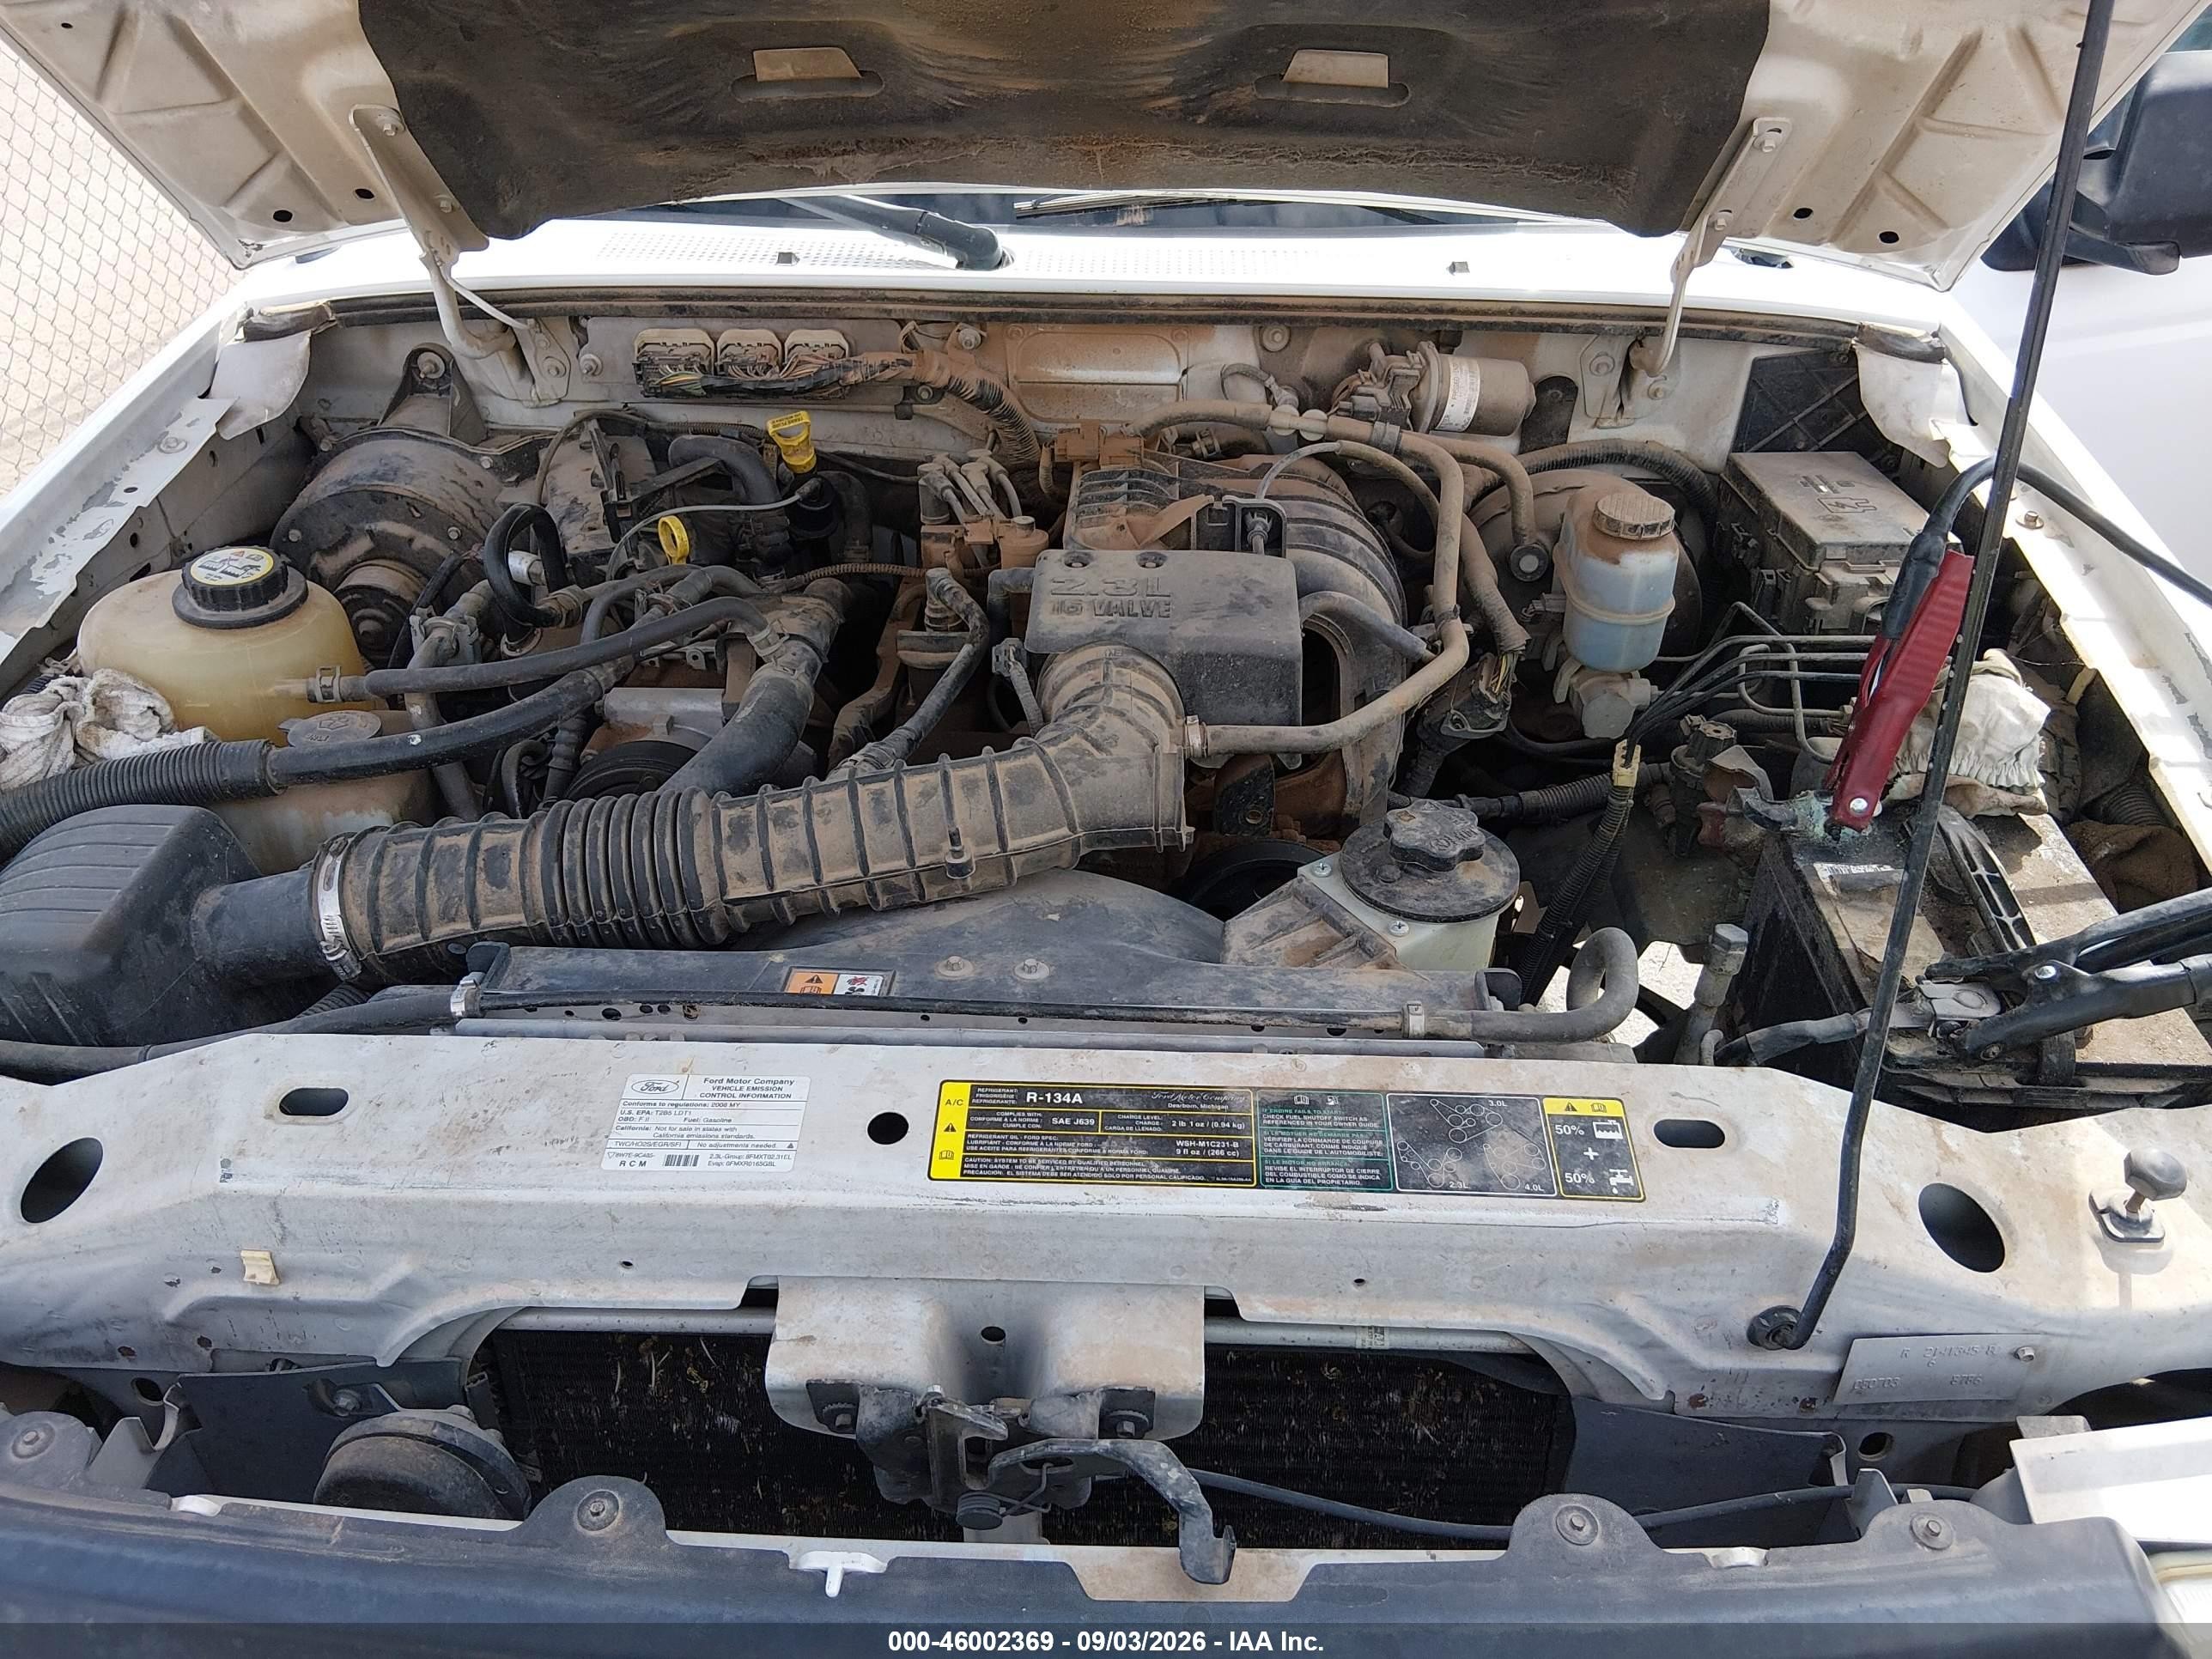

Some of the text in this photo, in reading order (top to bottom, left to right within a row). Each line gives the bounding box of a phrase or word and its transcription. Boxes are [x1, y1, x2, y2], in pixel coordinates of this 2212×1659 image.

[1050, 577, 1171, 598] 2.3L
[1092, 599, 1171, 618] VALVE
[641, 1082, 670, 1092] Ford
[1026, 1091, 1083, 1104] R-134A
[1554, 1125, 1585, 1136] 50%
[1565, 1172, 1595, 1185] 50%
[1449, 1181, 1469, 1189] 2.3L
[1524, 1183, 1544, 1192] 4.0L
